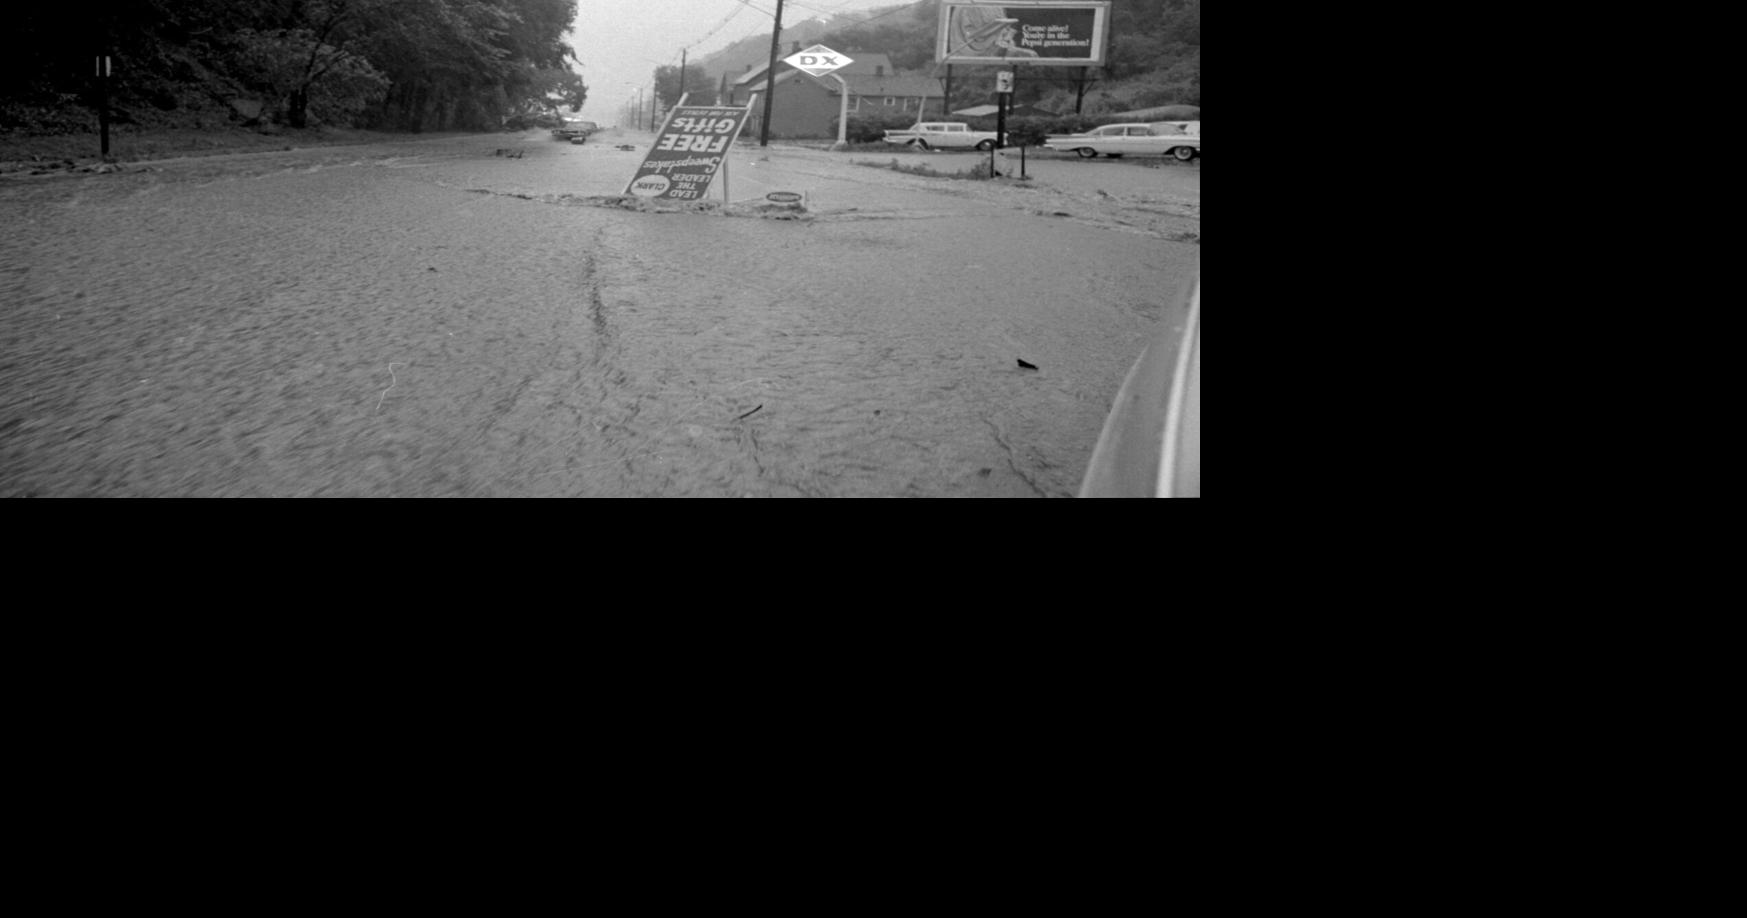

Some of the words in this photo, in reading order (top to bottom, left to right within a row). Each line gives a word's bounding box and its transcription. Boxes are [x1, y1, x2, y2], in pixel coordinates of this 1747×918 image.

[1022, 24, 1047, 32] Come
[1047, 24, 1069, 32] alive!
[1021, 38, 1042, 48] Pepsi
[1043, 39, 1089, 48] generation!
[800, 55, 839, 66] DX
[672, 117, 735, 133] Gifts
[657, 134, 728, 152] FREE
[642, 155, 721, 174] Sweepstakes
[671, 173, 711, 182] LEADER
[635, 182, 667, 191] CLARK
[675, 181, 697, 190] THE
[670, 190, 698, 198] LEAD
